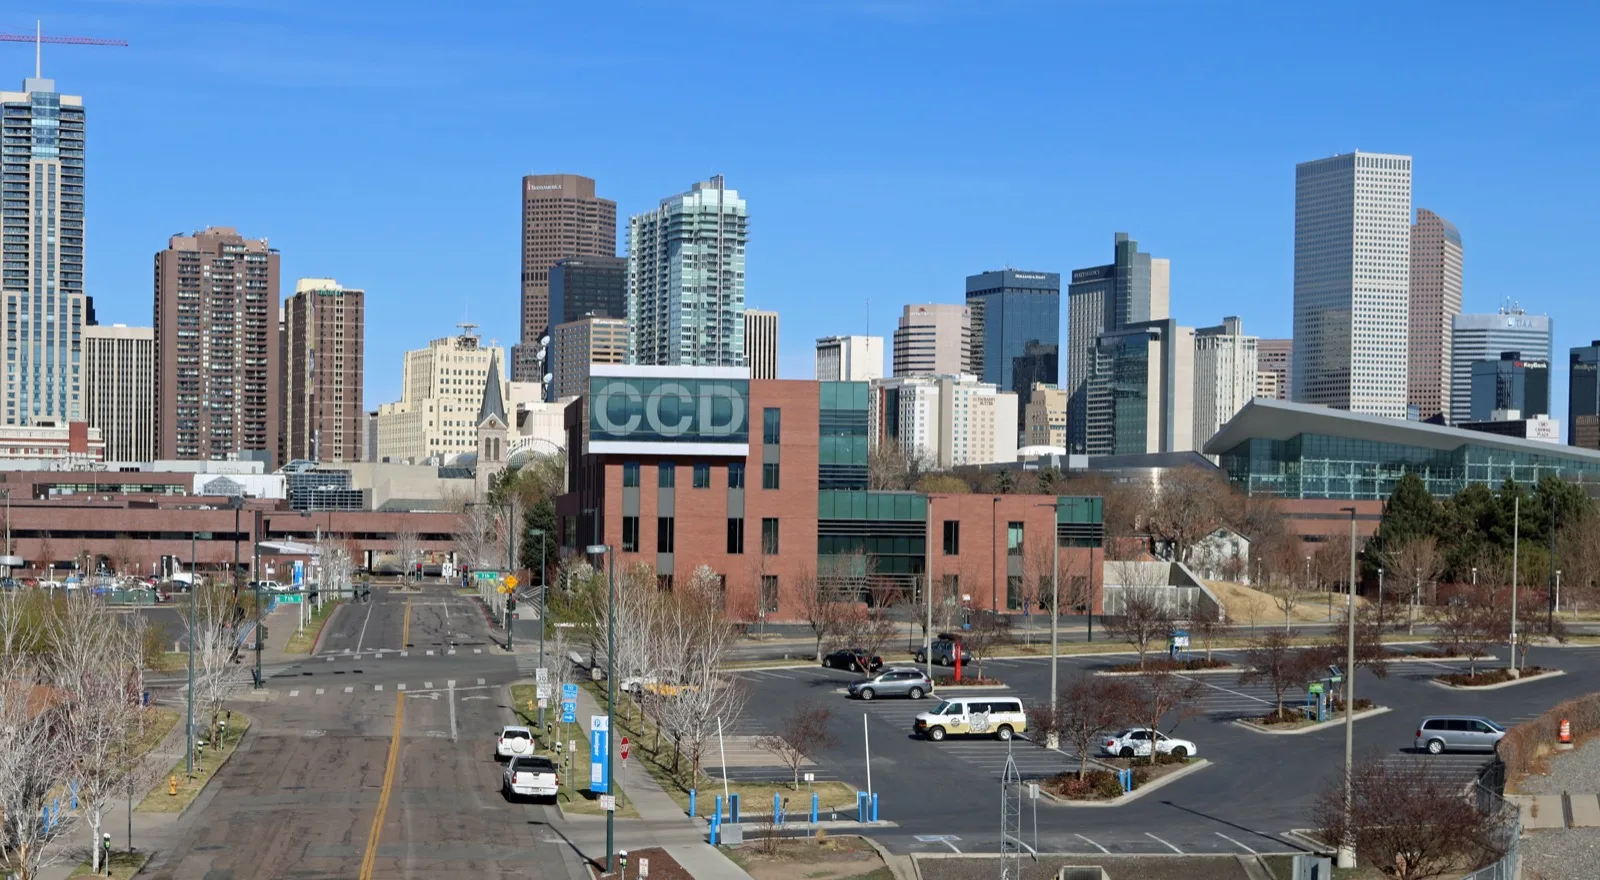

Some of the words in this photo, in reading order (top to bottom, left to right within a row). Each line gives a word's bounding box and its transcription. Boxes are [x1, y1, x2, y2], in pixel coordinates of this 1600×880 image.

[1523, 361, 1547, 370] KeyBank
[595, 382, 745, 437] CCD
[564, 703, 574, 711] 25
